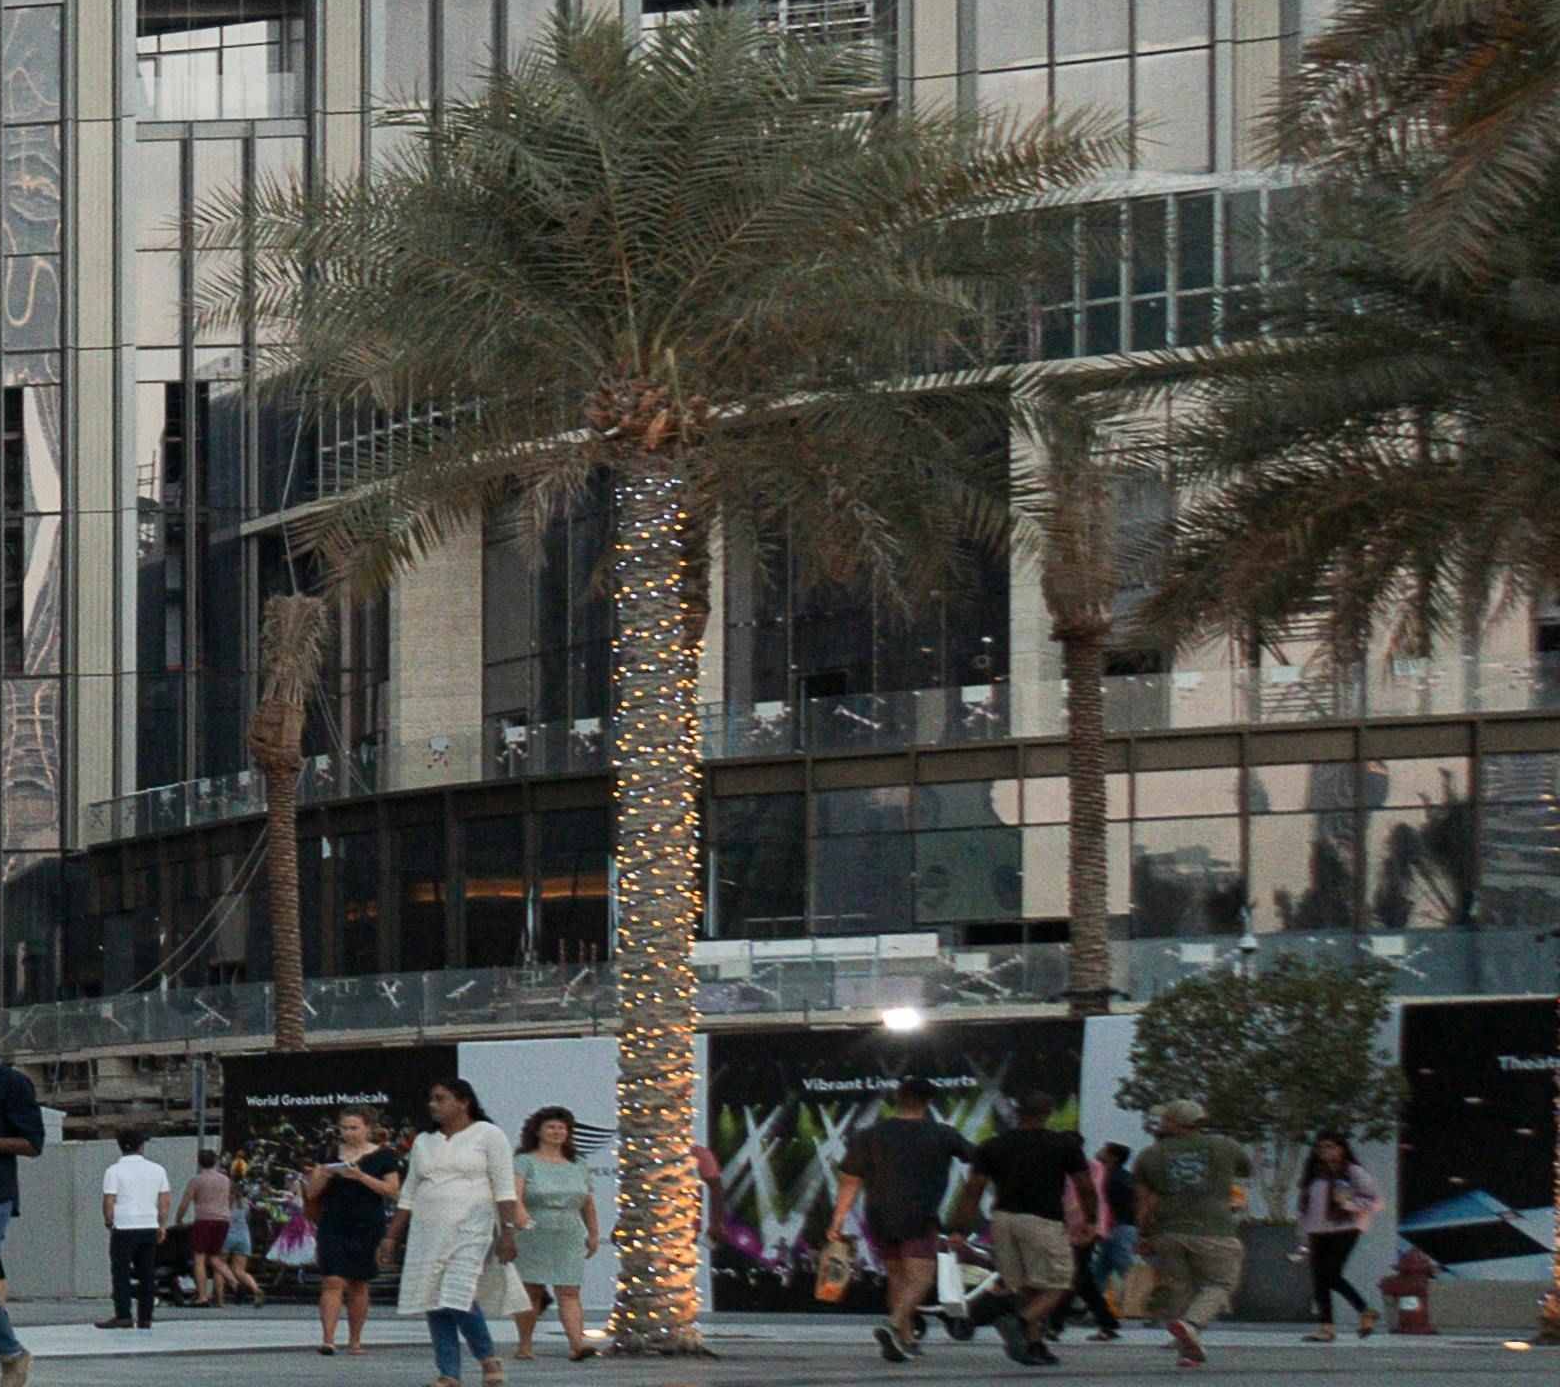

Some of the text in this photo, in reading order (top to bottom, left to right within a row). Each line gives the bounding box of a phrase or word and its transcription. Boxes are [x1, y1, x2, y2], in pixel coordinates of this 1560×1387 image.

[802, 1077, 862, 1091] Vibrant
[865, 1077, 901, 1090] Live
[246, 1091, 389, 1107] World Greatest Musicals
